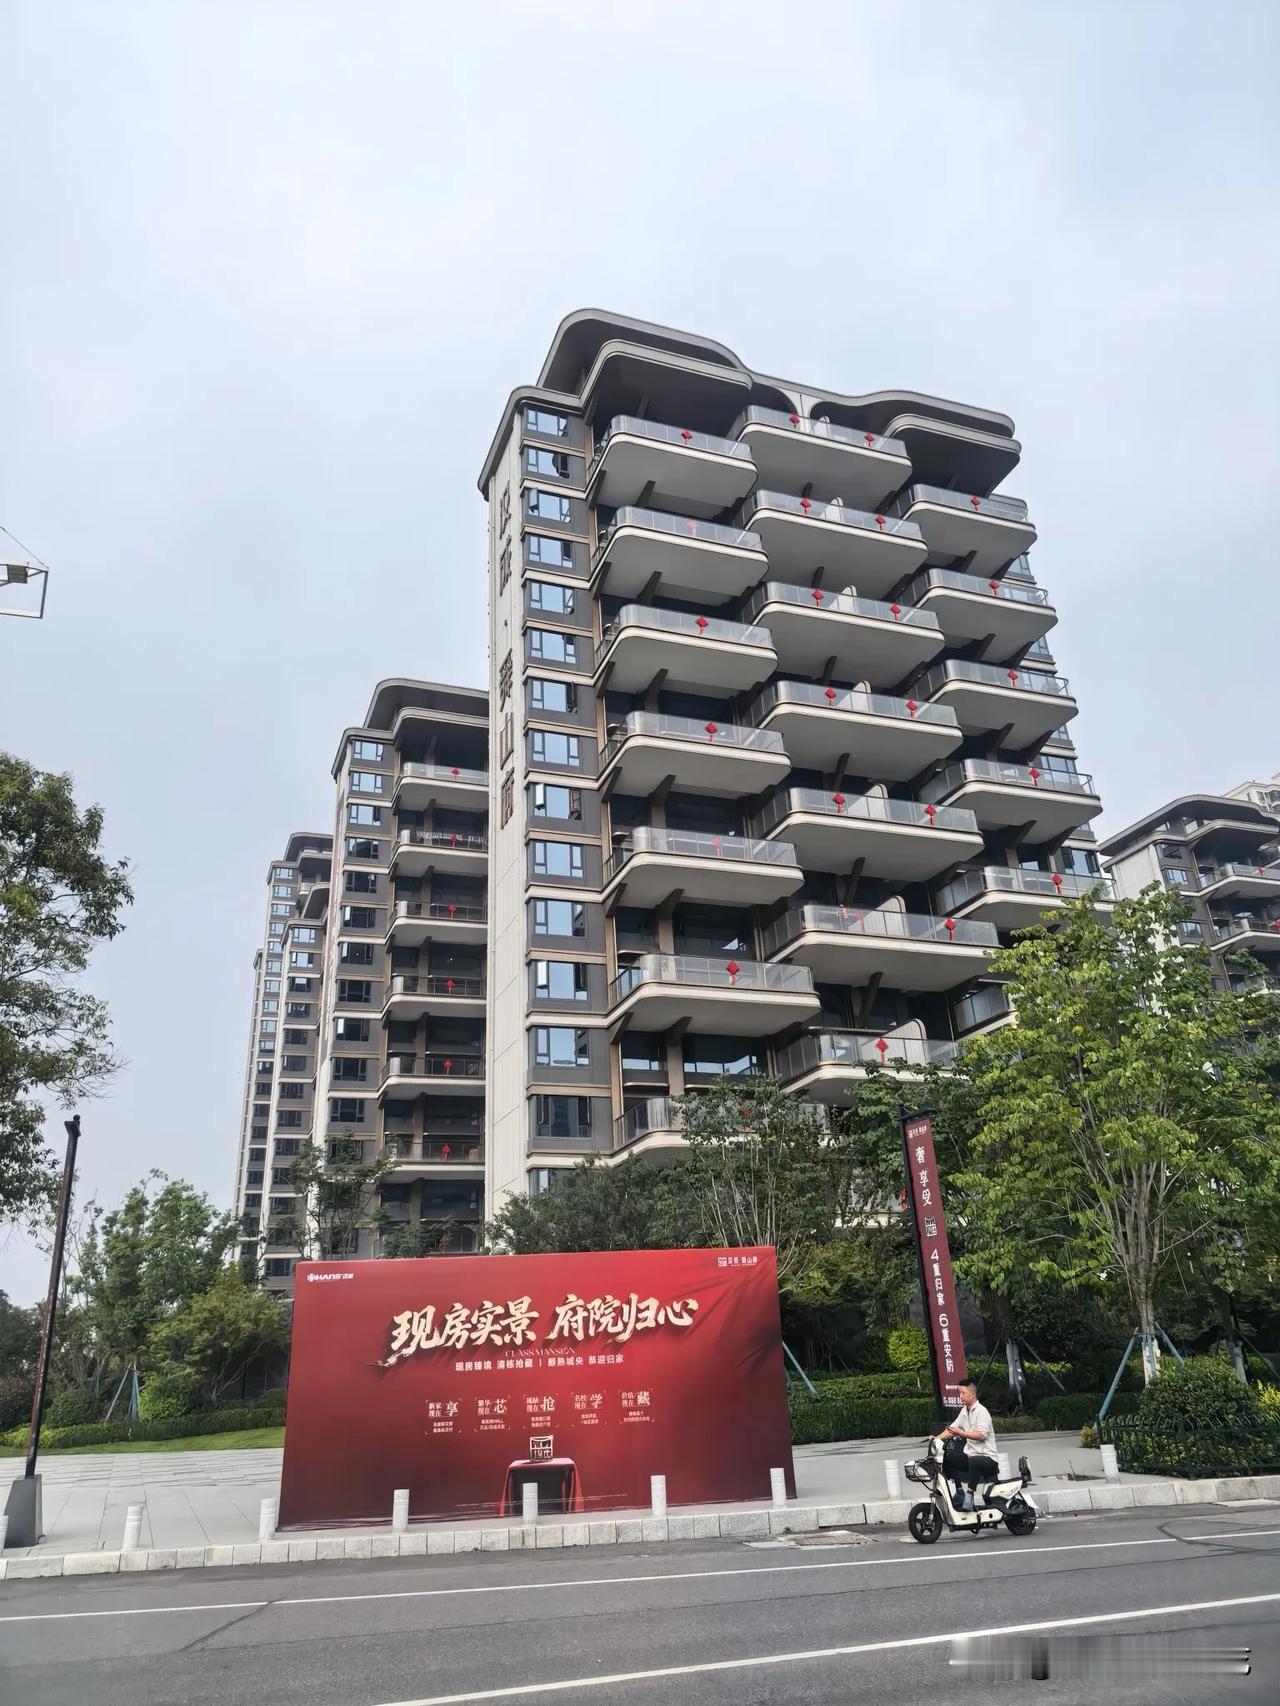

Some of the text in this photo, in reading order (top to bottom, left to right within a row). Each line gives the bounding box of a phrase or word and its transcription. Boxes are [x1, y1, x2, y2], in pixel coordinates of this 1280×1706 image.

[930, 1247, 945, 1307] 4重归家
[376, 1292, 698, 1363] 现房实景 府院归心
[938, 1312, 954, 1374] 6重安防
[446, 1400, 458, 1417] 享
[493, 1398, 507, 1413] 芯
[542, 1396, 555, 1411] 抢
[590, 1393, 603, 1409] 学
